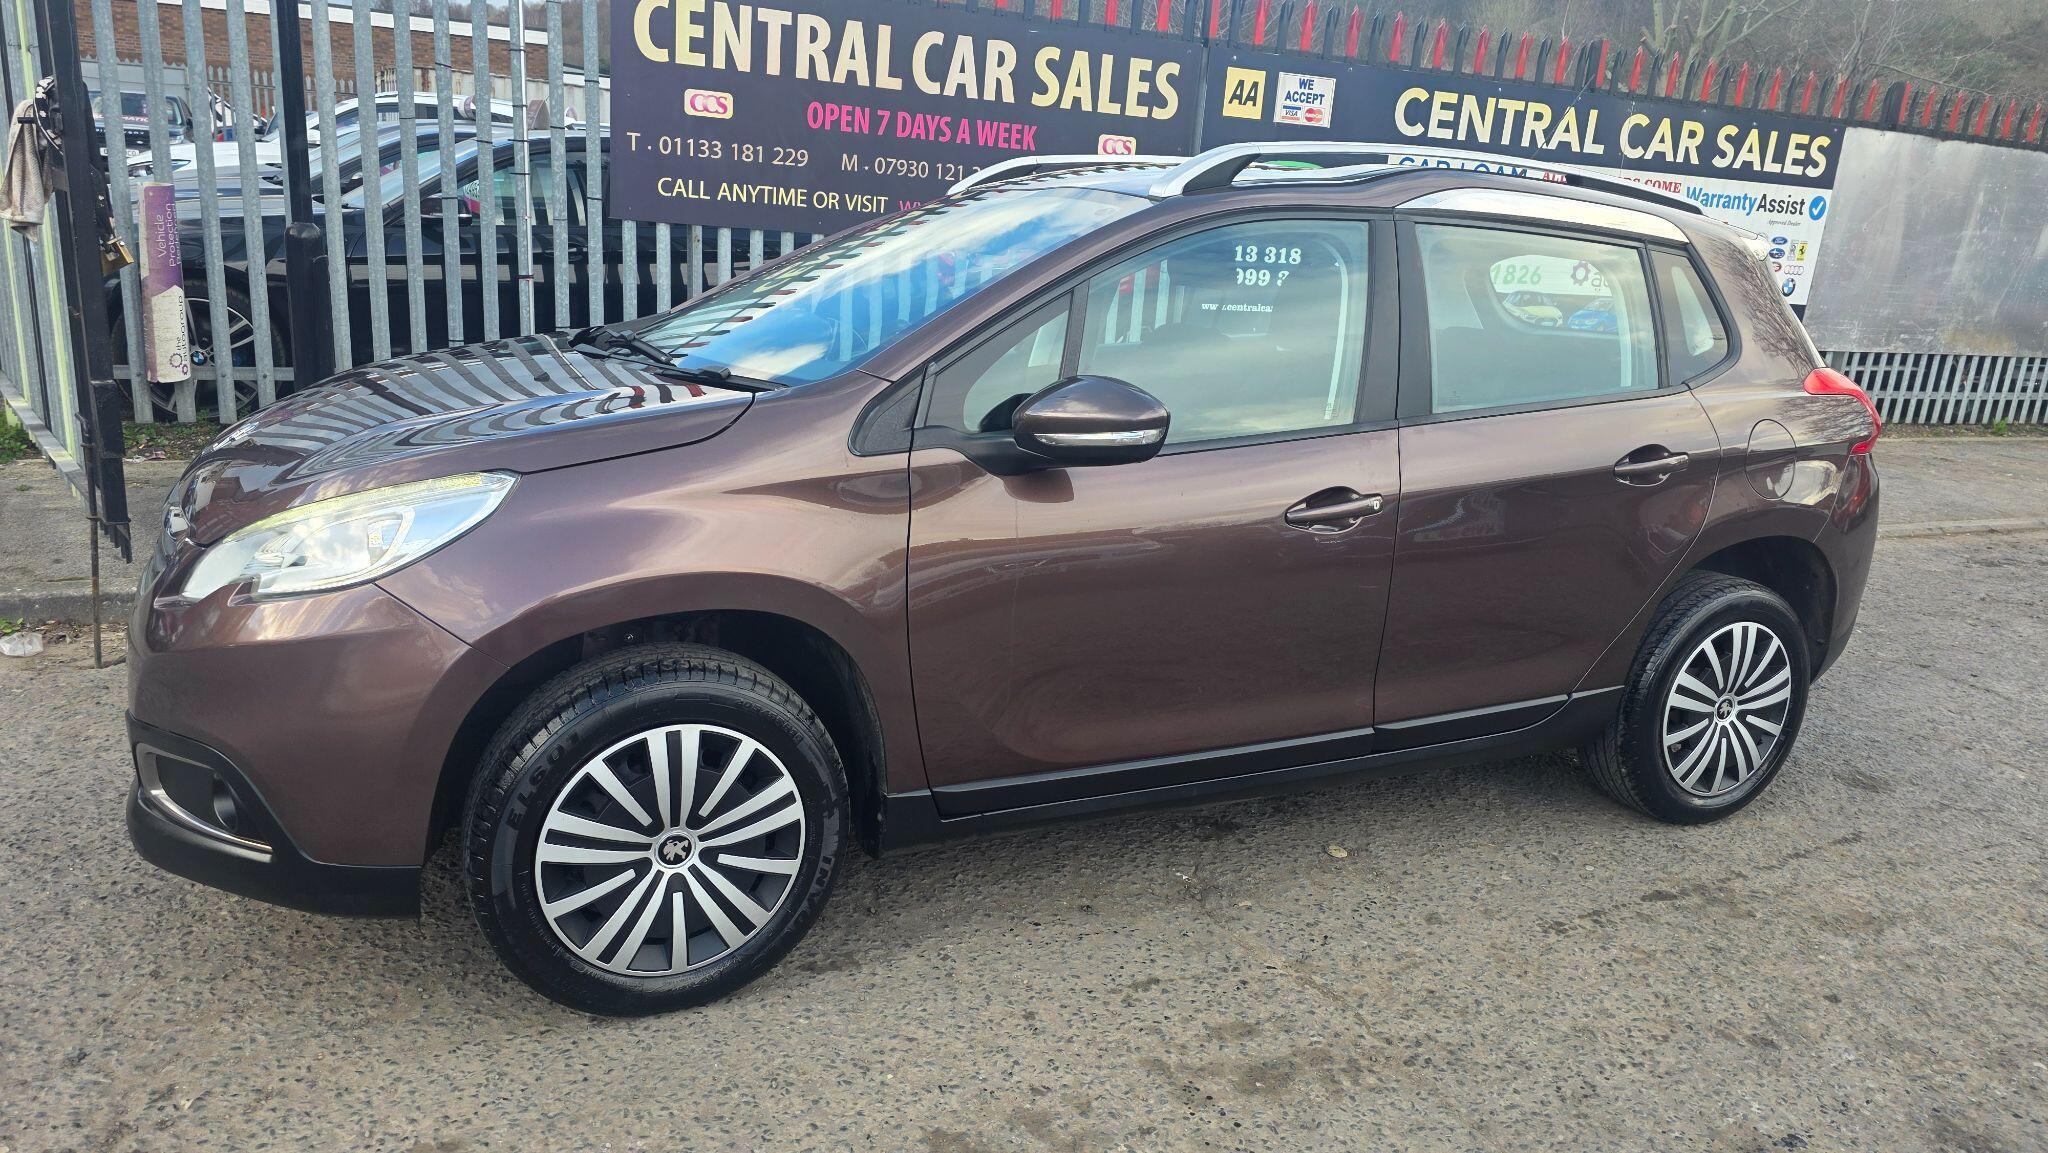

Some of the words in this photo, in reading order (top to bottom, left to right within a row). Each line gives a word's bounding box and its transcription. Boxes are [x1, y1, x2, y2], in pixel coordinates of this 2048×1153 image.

[633, 0, 902, 90] CENTRAL
[912, 30, 1015, 104] CAR
[1030, 46, 1181, 120] SALES
[1228, 79, 1259, 107] AA
[1284, 90, 1325, 105] ACCEPT
[1299, 78, 1315, 91] WE
[807, 101, 870, 134] OPEN
[877, 109, 891, 136] 7
[896, 111, 952, 142] DAYS
[956, 118, 970, 145] A
[976, 119, 1038, 151] WEEK
[1394, 87, 1605, 155] CENTRAL
[1619, 113, 1705, 165] CAR
[1712, 124, 1831, 178] SALES
[659, 135, 722, 159] 01133
[731, 143, 763, 163] 181
[771, 147, 809, 167] 229
[874, 157, 929, 178] 07930
[936, 163, 964, 181] 121
[657, 177, 711, 200] CALL
[717, 182, 808, 208] ANYTIME
[813, 191, 839, 210] OR
[844, 194, 889, 214] VISIT
[154, 213, 166, 258] Vehicle
[165, 203, 177, 267] Protection
